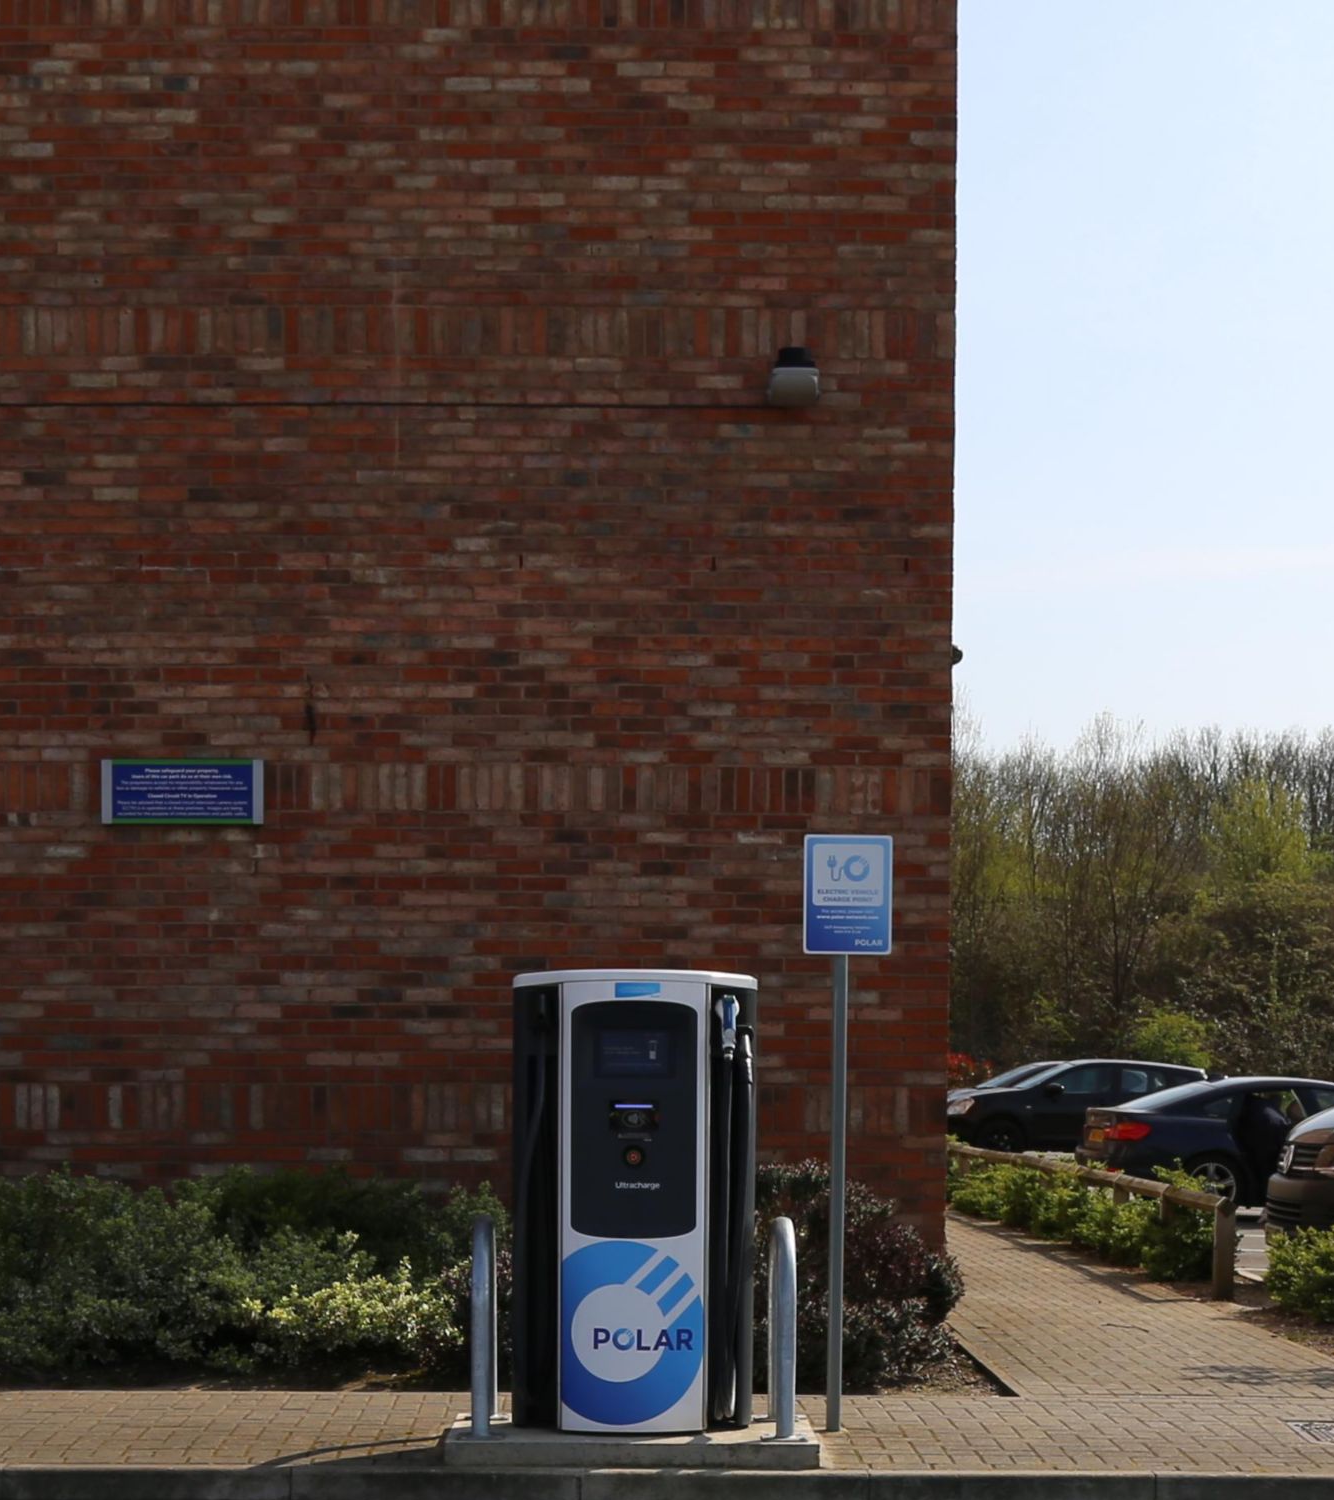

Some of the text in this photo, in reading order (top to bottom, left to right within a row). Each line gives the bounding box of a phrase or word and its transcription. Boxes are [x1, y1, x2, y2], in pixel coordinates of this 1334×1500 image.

[854, 938, 883, 946] POLAR
[614, 1181, 660, 1190] Ultracharge
[593, 1328, 693, 1351] POLAR
